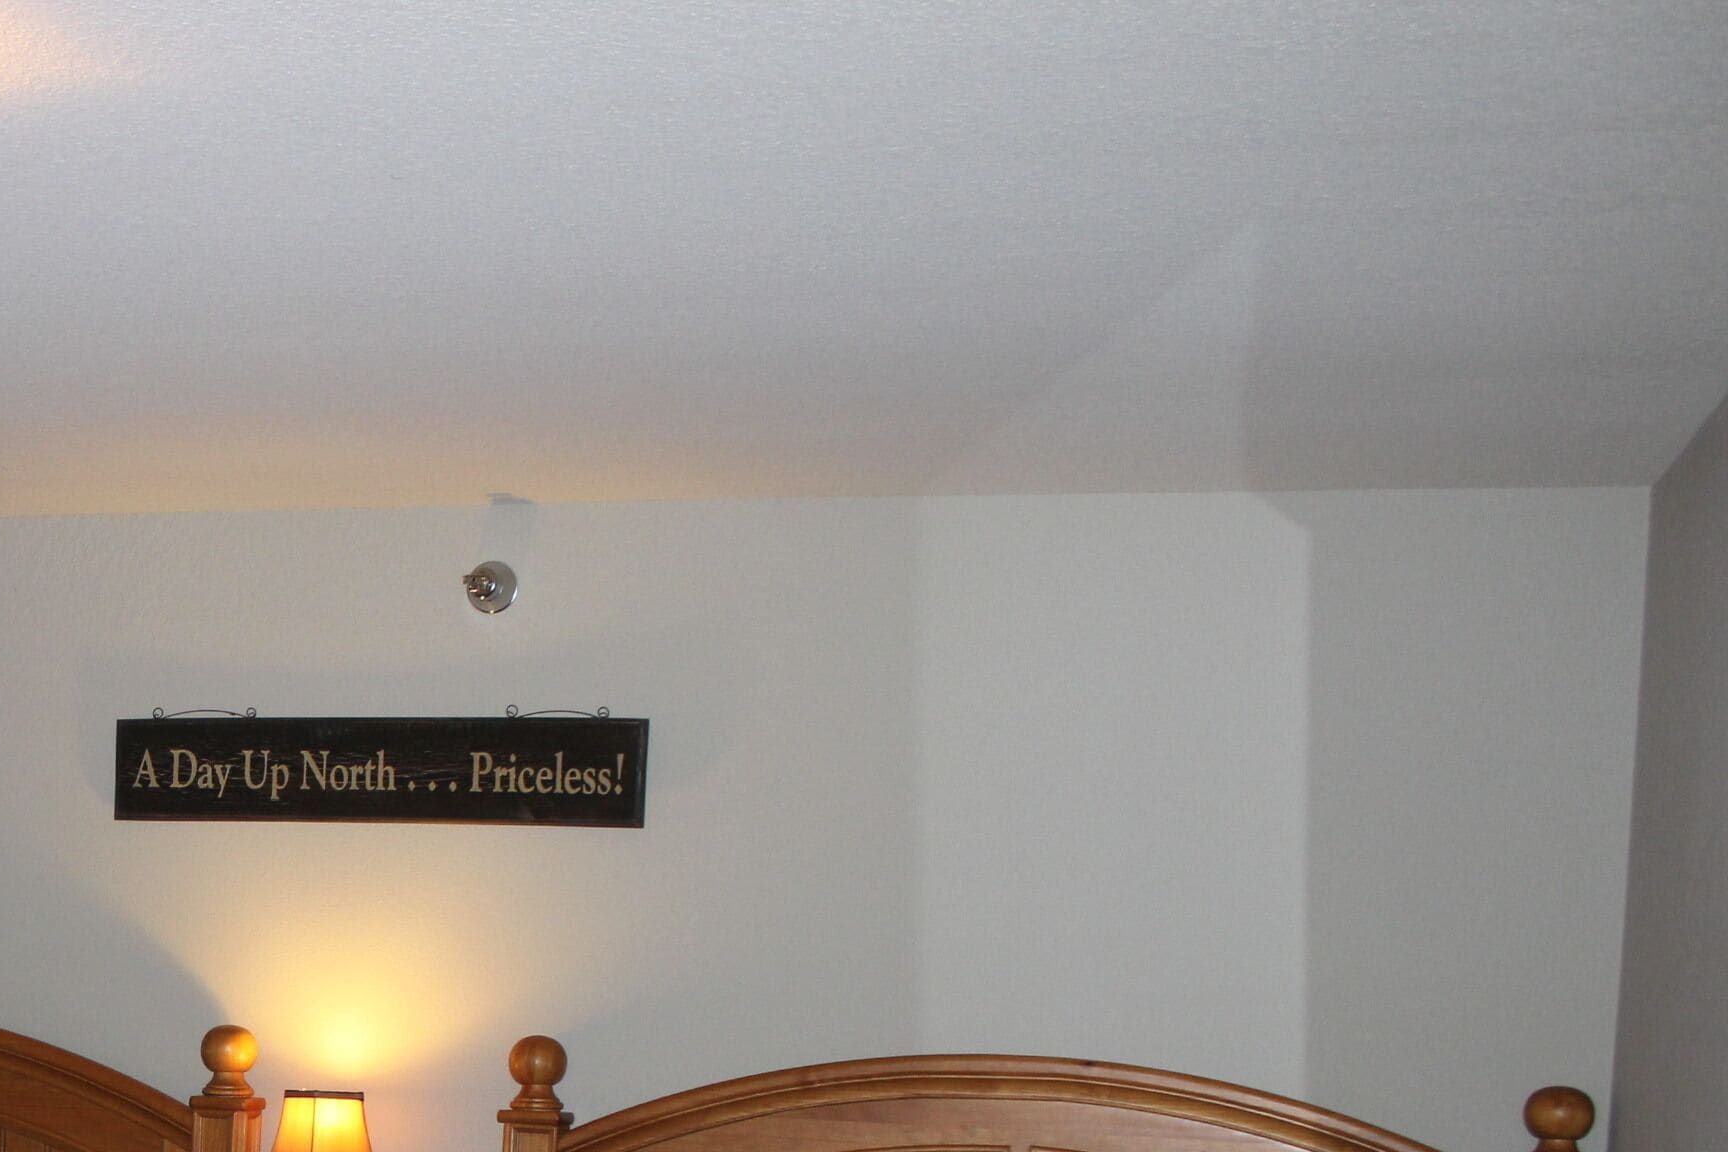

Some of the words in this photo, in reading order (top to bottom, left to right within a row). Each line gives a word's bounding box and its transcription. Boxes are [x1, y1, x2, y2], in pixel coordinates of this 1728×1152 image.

[131, 749, 160, 788] A
[169, 748, 232, 799] Day
[242, 749, 290, 800] Up
[299, 749, 397, 792] North
[468, 750, 626, 796] Priceless!
